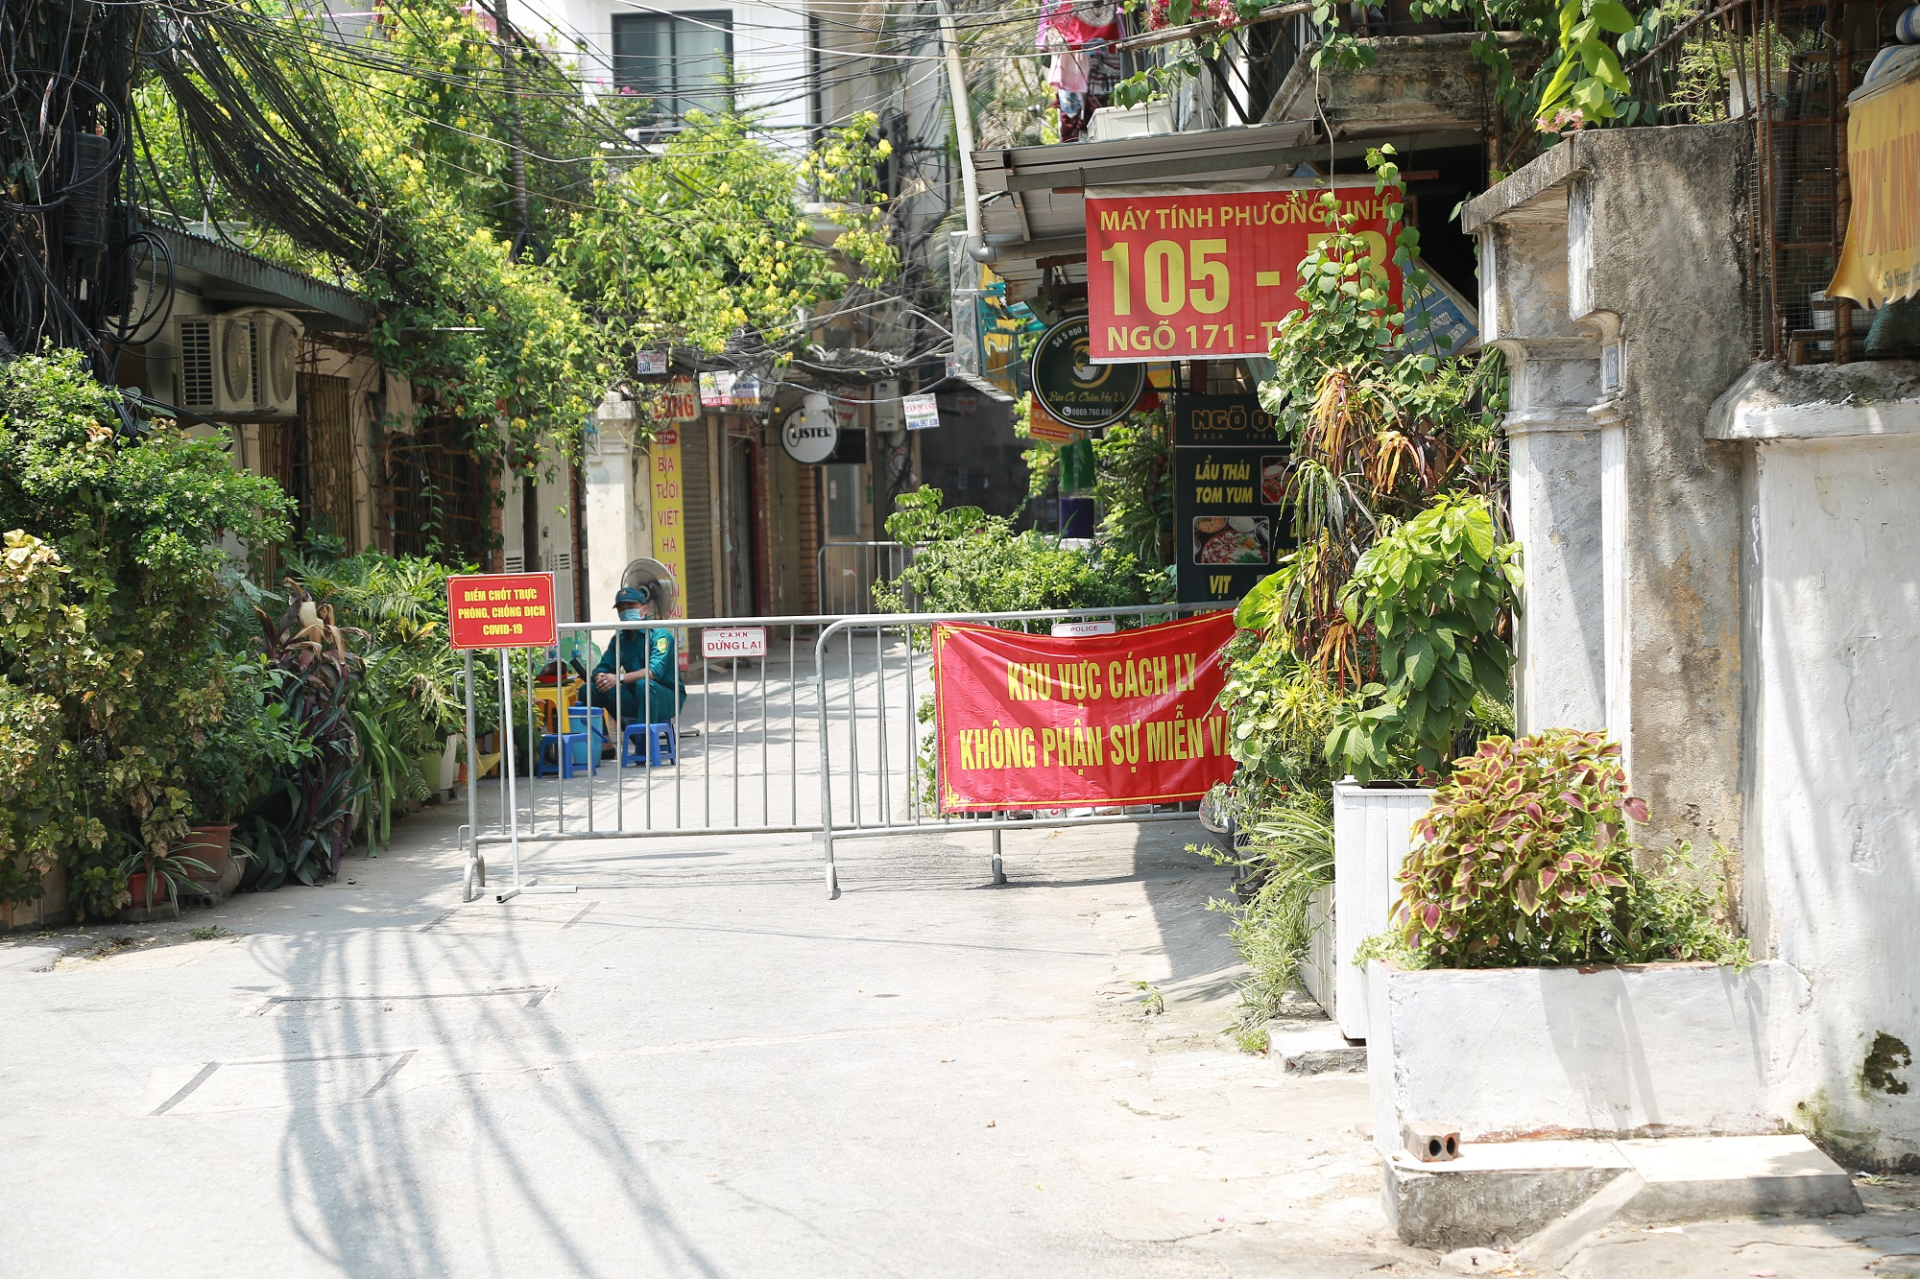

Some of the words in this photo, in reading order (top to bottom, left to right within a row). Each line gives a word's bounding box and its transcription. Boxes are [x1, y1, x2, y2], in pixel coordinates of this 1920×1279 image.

[1101, 206, 1151, 231] MÁY
[1155, 204, 1213, 229] TÍNH
[1220, 201, 1325, 227] PHƯƠNG
[1101, 239, 1230, 316] 105
[1061, 331, 1069, 340] 5
[1107, 320, 1176, 351] NGÕ
[1185, 324, 1234, 349] 171
[658, 456, 674, 471] BIA
[1195, 455, 1220, 480] LẨU
[1222, 460, 1250, 480] THÁI
[1196, 487, 1222, 503] TOM
[1226, 487, 1253, 503] YUM
[464, 587, 486, 602] ĐIỂM
[488, 586, 512, 601] CHỐT
[513, 587, 537, 602] TRỰC
[1209, 575, 1232, 600] VỊT
[458, 606, 490, 619] PHÒNG,
[491, 603, 522, 618] CHỐNG
[523, 605, 546, 619] DỊCH
[482, 623, 523, 635] COVID-19
[707, 639, 740, 651] DỪNG
[742, 640, 761, 652] LẠI
[1006, 662, 1052, 701] KHU
[1057, 659, 1102, 709] VỰC
[1108, 651, 1169, 699] CÁCH
[1174, 653, 1197, 693] LY
[959, 719, 1036, 770] KHÔNG
[1041, 718, 1103, 776] PHẬN
[1110, 718, 1141, 773] SỰ
[1145, 704, 1204, 763] MIỄN
